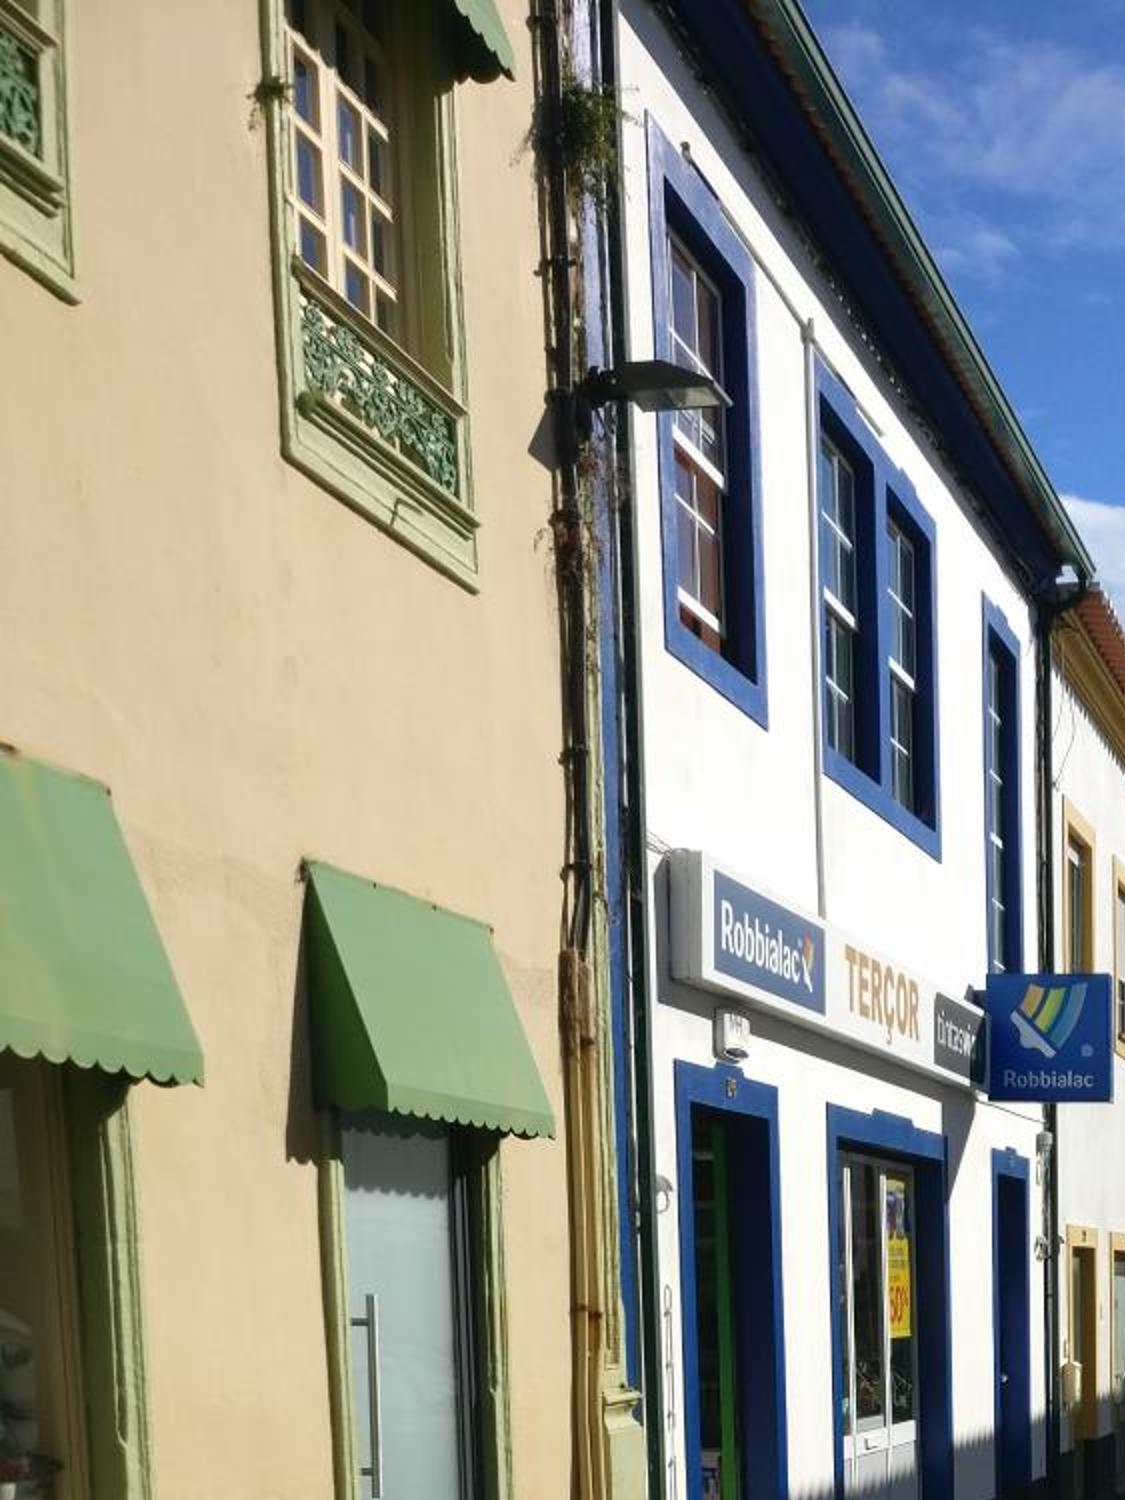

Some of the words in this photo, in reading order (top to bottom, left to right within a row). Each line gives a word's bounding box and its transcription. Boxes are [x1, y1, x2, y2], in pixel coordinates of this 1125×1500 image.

[721, 899, 800, 984] Robbialac
[845, 943, 920, 1045] TERÇOR
[1004, 1069, 1094, 1089] Robbialac
